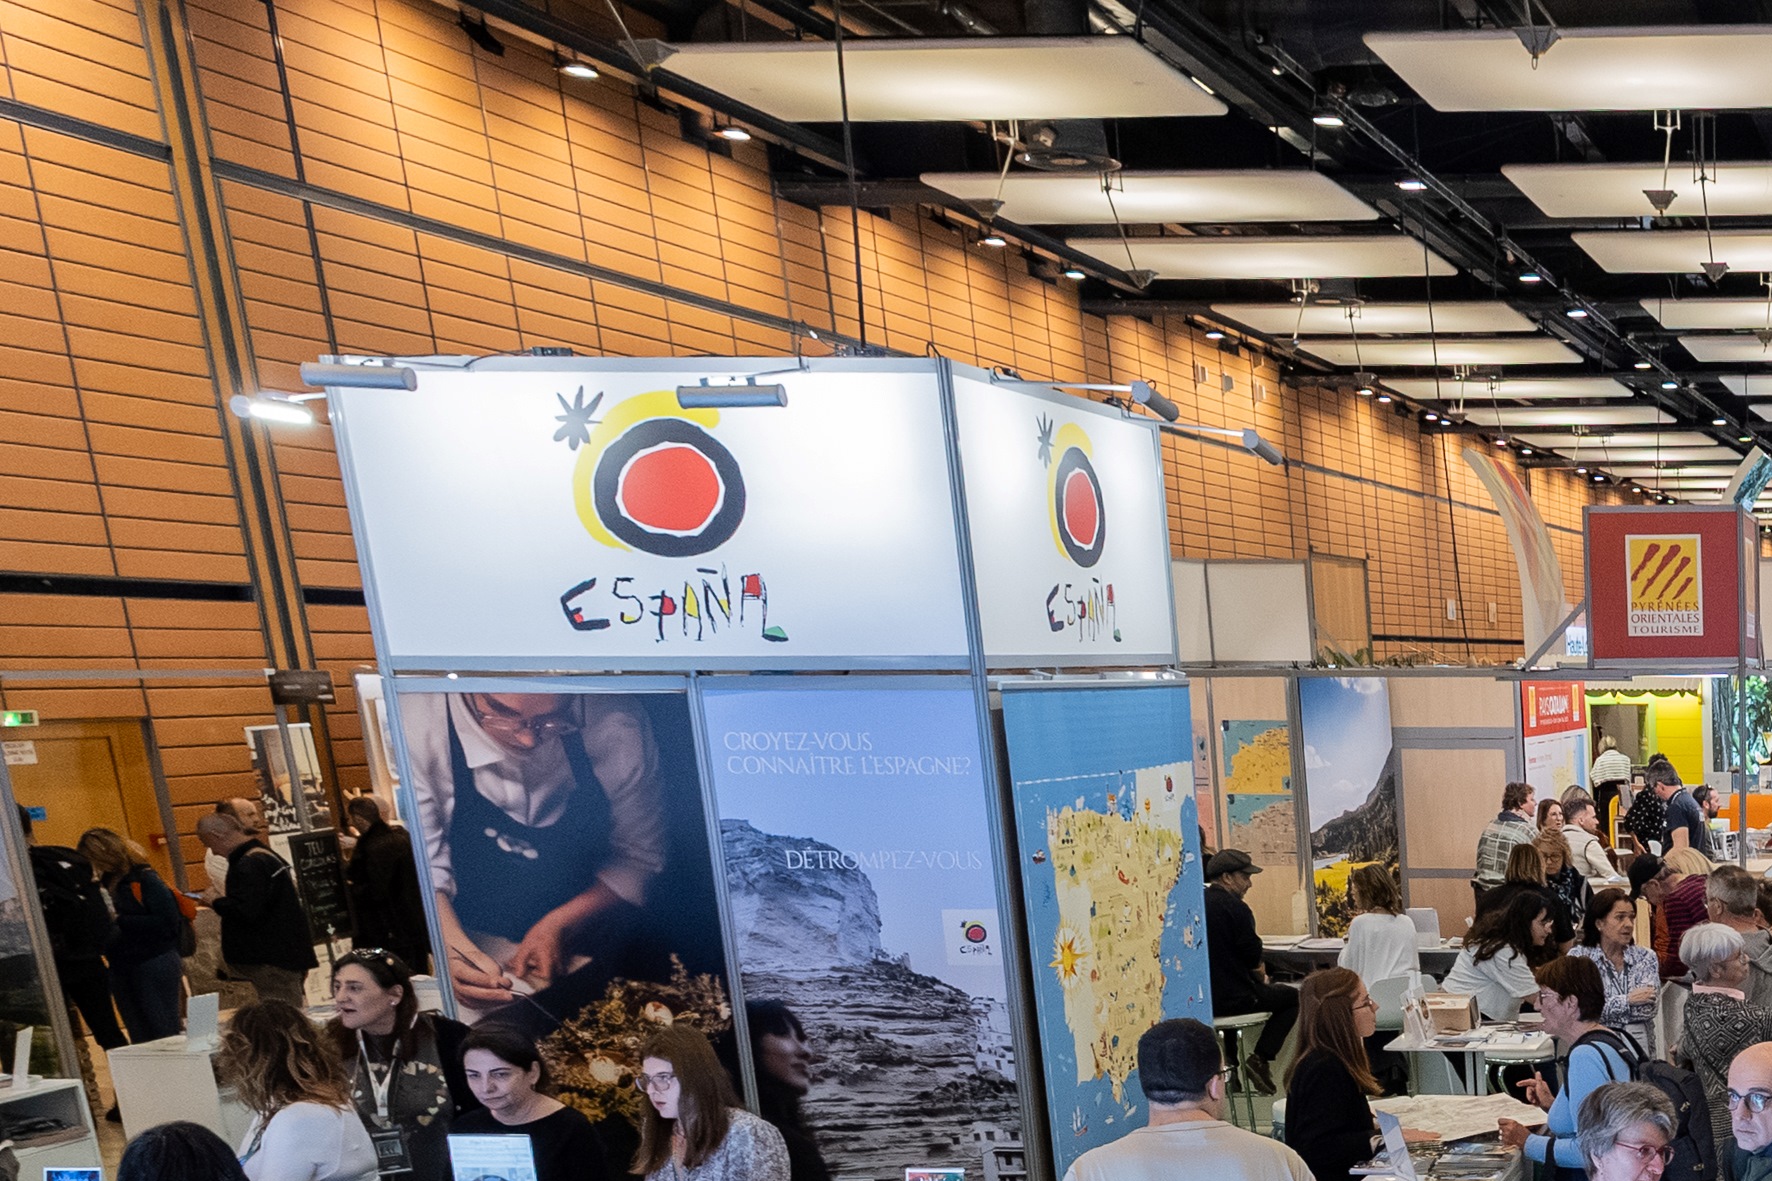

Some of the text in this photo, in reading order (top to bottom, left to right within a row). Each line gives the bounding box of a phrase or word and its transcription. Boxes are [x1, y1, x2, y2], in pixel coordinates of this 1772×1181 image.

[560, 563, 789, 643] ESPAÑA
[1045, 575, 1121, 643] ESPAÑA
[1630, 600, 1700, 612] PYRÉNÉES
[1630, 613, 1700, 624] ORIENTALES
[1632, 625, 1701, 635] TOURISME
[723, 731, 874, 752] CROYEZ-VOUS
[727, 753, 972, 777] CONNAÎTRE L'ESPAGNE?
[784, 846, 983, 871] DÉTROMPEZ-VOUS
